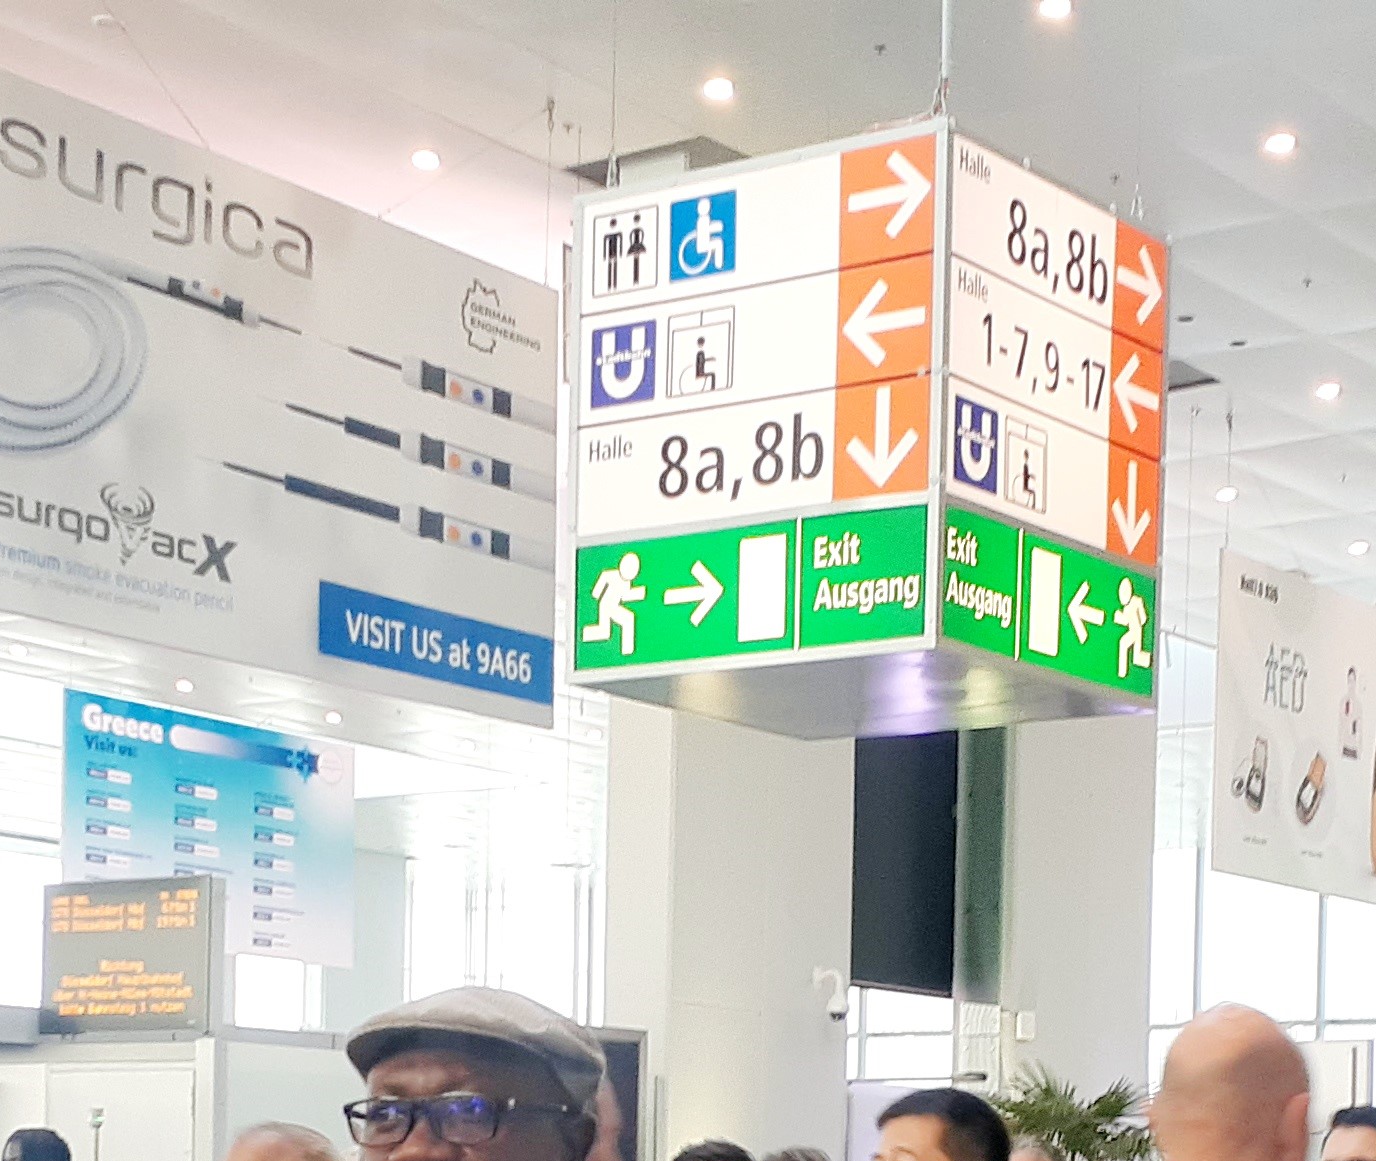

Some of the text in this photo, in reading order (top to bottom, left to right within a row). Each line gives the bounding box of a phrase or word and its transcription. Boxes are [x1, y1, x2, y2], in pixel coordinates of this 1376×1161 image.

[959, 146, 992, 185] Halle
[1006, 197, 1109, 306] 8a,8b
[957, 266, 990, 304] Halle
[469, 302, 517, 327] GERMAN
[469, 315, 542, 352] ENGINEERING
[588, 434, 634, 462] Halle
[658, 411, 825, 502] 8a,8b
[813, 531, 862, 570] Exit
[945, 526, 979, 568] Exit
[812, 573, 921, 614] Ausgang
[945, 571, 1013, 627] Ausgang
[345, 608, 532, 685] VISIT US at 9A66
[82, 702, 165, 745] Greece
[83, 735, 116, 753] Visit
